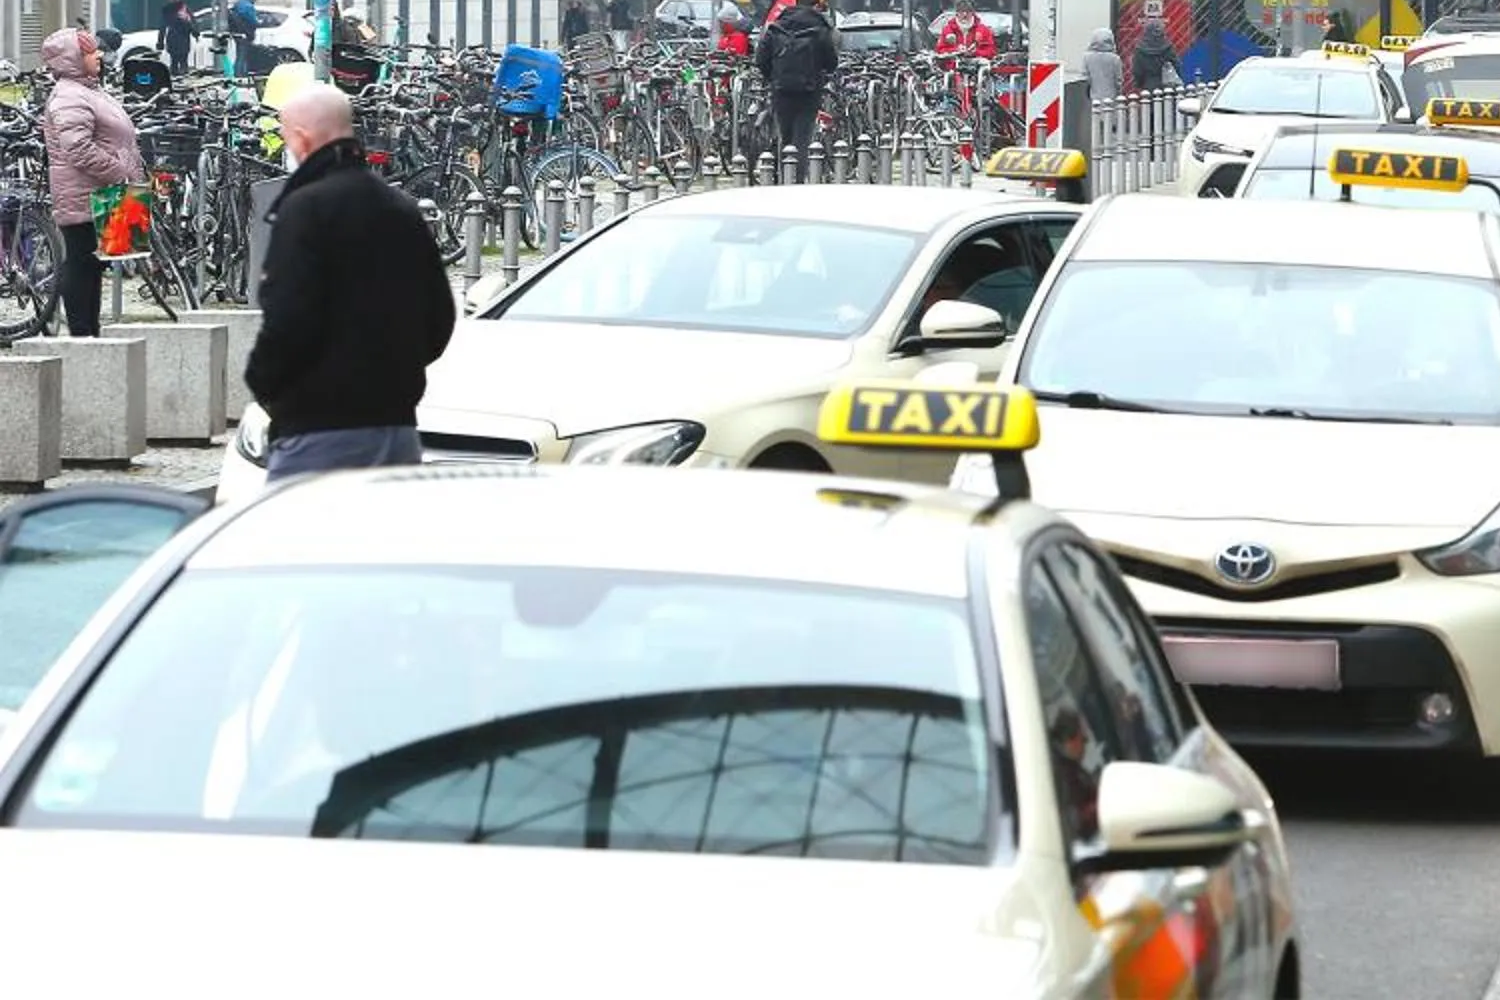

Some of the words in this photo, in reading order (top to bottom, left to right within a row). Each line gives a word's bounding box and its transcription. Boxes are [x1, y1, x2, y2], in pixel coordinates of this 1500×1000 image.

[1003, 151, 1065, 171] TAXI
[1350, 151, 1443, 179] TAXI
[857, 390, 1003, 434] TAXI
